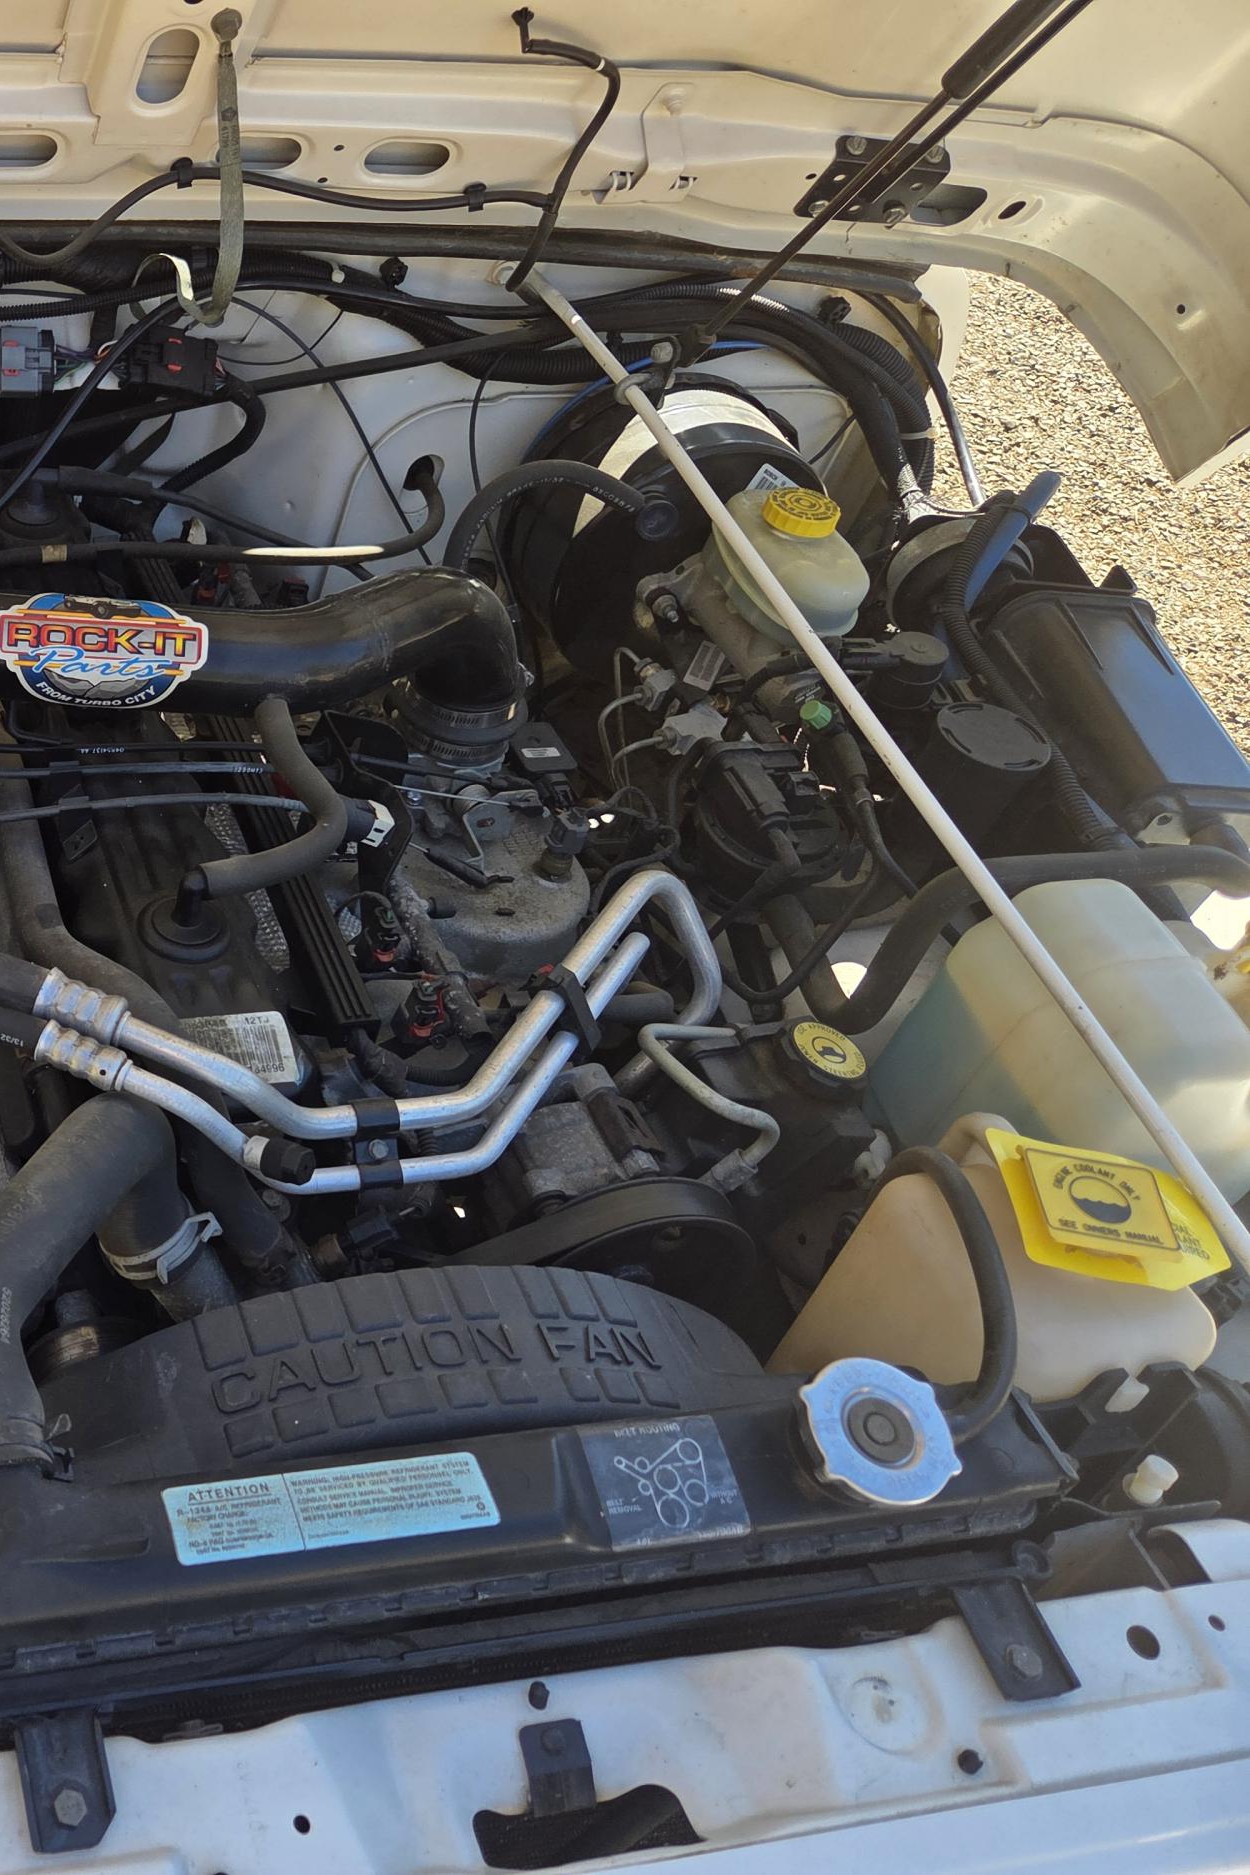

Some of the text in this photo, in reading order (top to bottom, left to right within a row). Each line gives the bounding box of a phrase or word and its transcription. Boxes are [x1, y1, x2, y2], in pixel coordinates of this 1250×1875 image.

[7, 621, 197, 658] ROCK-IT
[29, 645, 172, 679] Parts
[36, 681, 157, 706] FROM TURBO CITY
[0, 1032, 24, 1047] 13/32
[1072, 1163, 1117, 1181] COOLANT
[1058, 1217, 1079, 1231] SEE
[211, 1322, 663, 1415] CAUTION FAN
[188, 1482, 270, 1502] ATTENTION
[608, 1504, 643, 1515] REMOVAL
